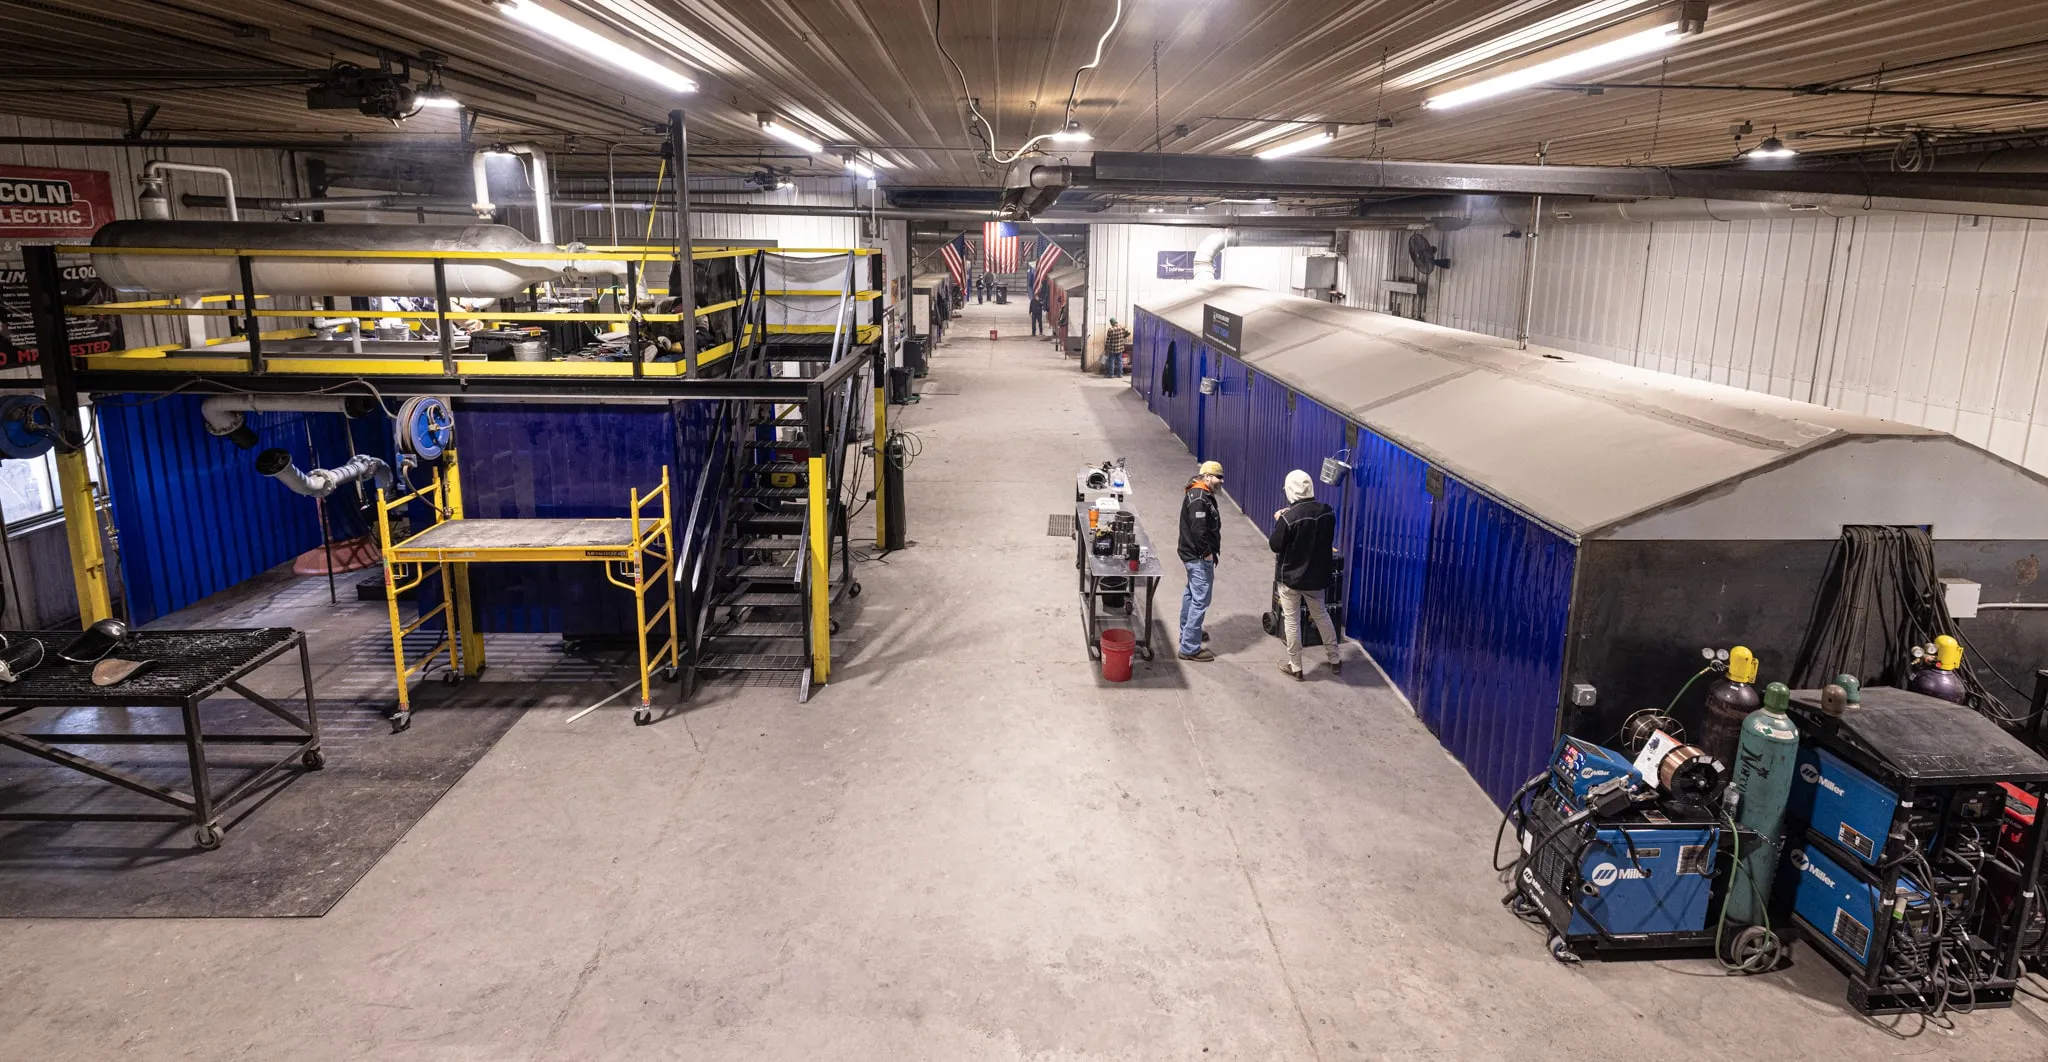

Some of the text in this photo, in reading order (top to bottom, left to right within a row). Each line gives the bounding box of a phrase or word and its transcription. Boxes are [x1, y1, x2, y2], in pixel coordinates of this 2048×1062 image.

[69, 340, 111, 357] ESTED
[1818, 775, 1846, 797] Miller
[1809, 863, 1836, 889] Miller
